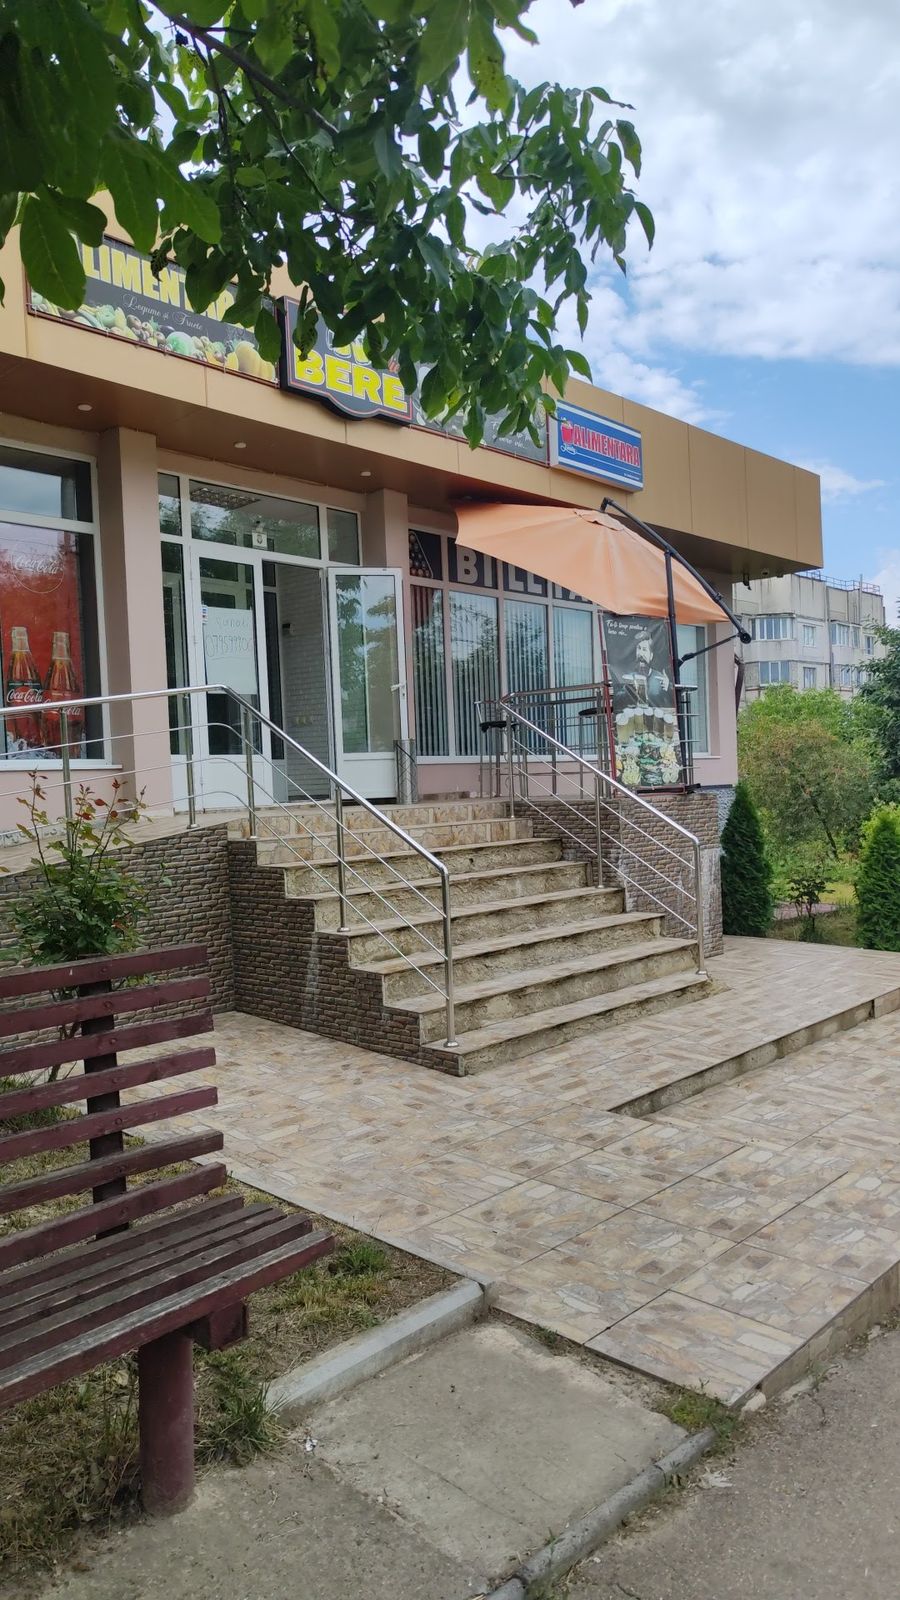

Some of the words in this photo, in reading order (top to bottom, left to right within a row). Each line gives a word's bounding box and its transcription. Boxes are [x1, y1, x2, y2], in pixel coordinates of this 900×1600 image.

[122, 293, 161, 316] Legume
[172, 311, 203, 331] Fructe
[293, 344, 408, 413] BERE
[573, 423, 640, 468] ALIMENTARA
